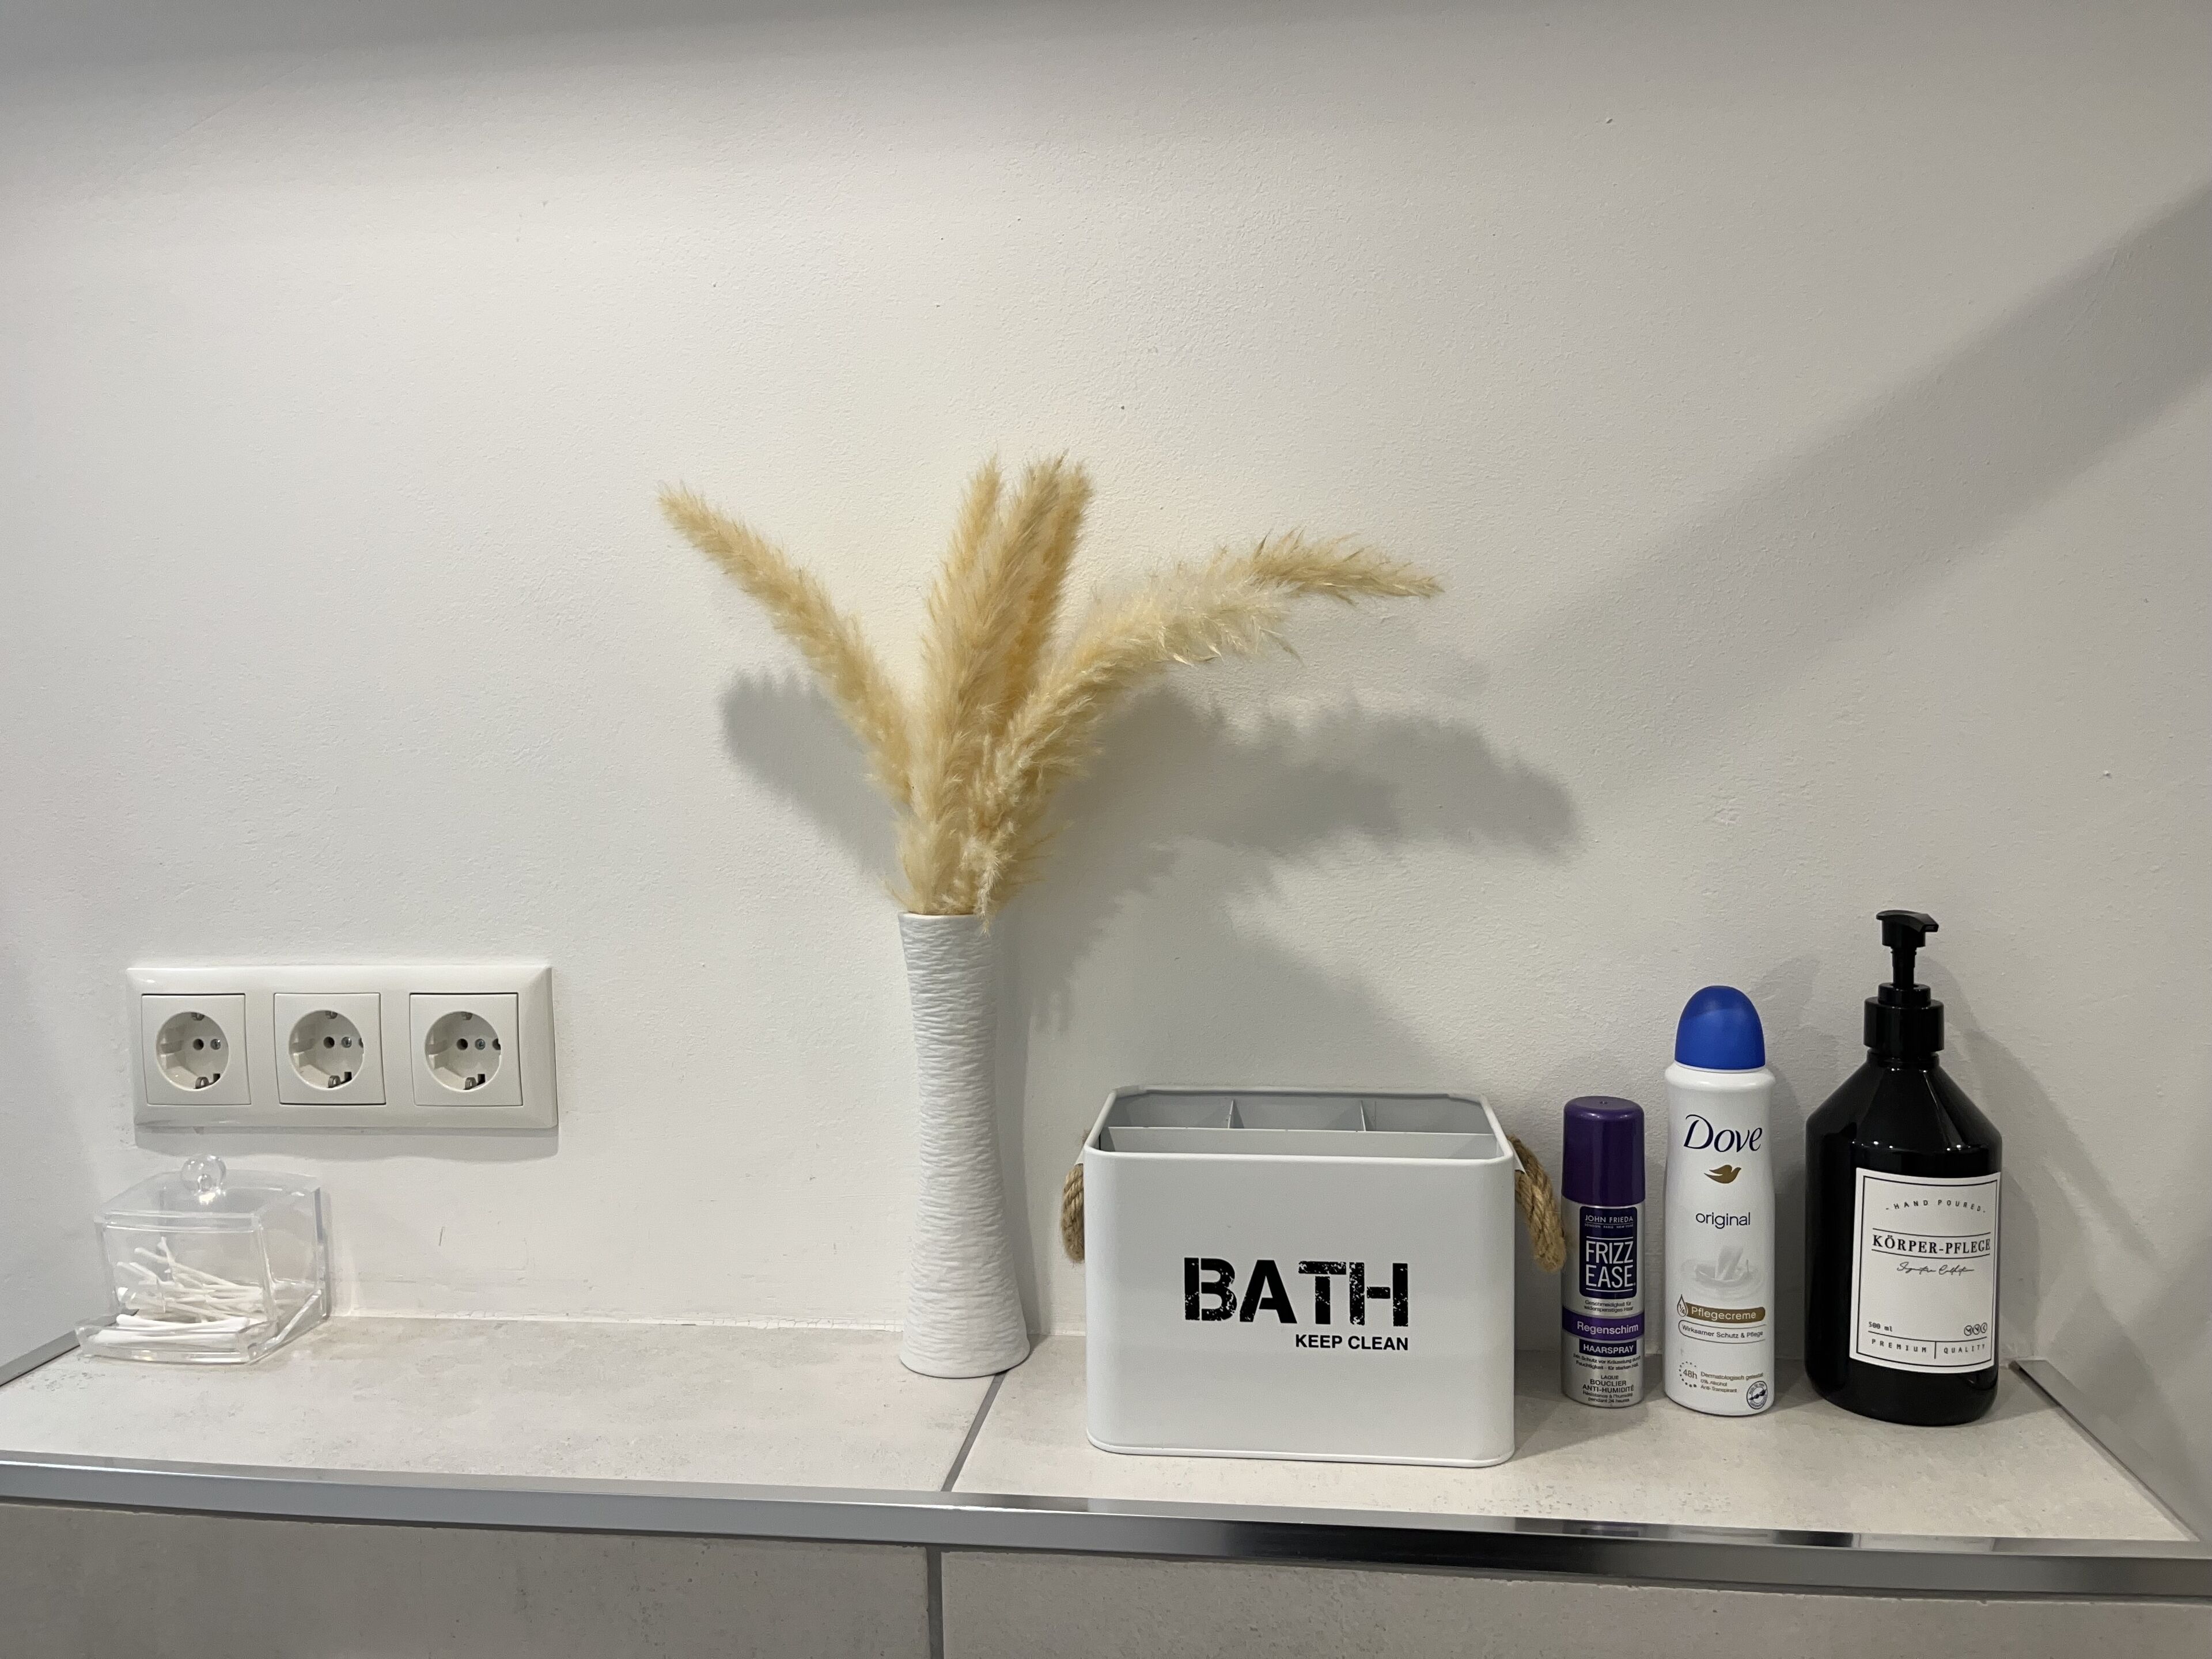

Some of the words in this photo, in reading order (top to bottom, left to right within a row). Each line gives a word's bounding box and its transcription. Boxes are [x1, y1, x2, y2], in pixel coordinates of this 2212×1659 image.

[1683, 1114, 1763, 1152] Dove
[1893, 1200, 1928, 1210] HAND
[1938, 1200, 1981, 1211] POURED
[1696, 1212, 1750, 1229] original
[1872, 1234, 1991, 1254] KÖRPER-PFLEGE
[1586, 1240, 1634, 1264] FRIZZ
[1586, 1264, 1634, 1288] EASE
[1184, 1257, 1408, 1327] BATH
[1691, 1306, 1756, 1321] Pflegecreme
[1577, 1321, 1639, 1334] Regenschirm
[1682, 1324, 1714, 1336] Wirksamer
[1296, 1334, 1343, 1348] KEEP
[1348, 1336, 1408, 1350] CLEAN
[1583, 1344, 1634, 1354] HAARSPRAY
[1872, 1339, 1926, 1353] PREMIUM
[1944, 1344, 1985, 1354] QUALITY
[1683, 1369, 1698, 1379] 48h
[1582, 1384, 1634, 1393] ANTI-HUMIDITÉ
